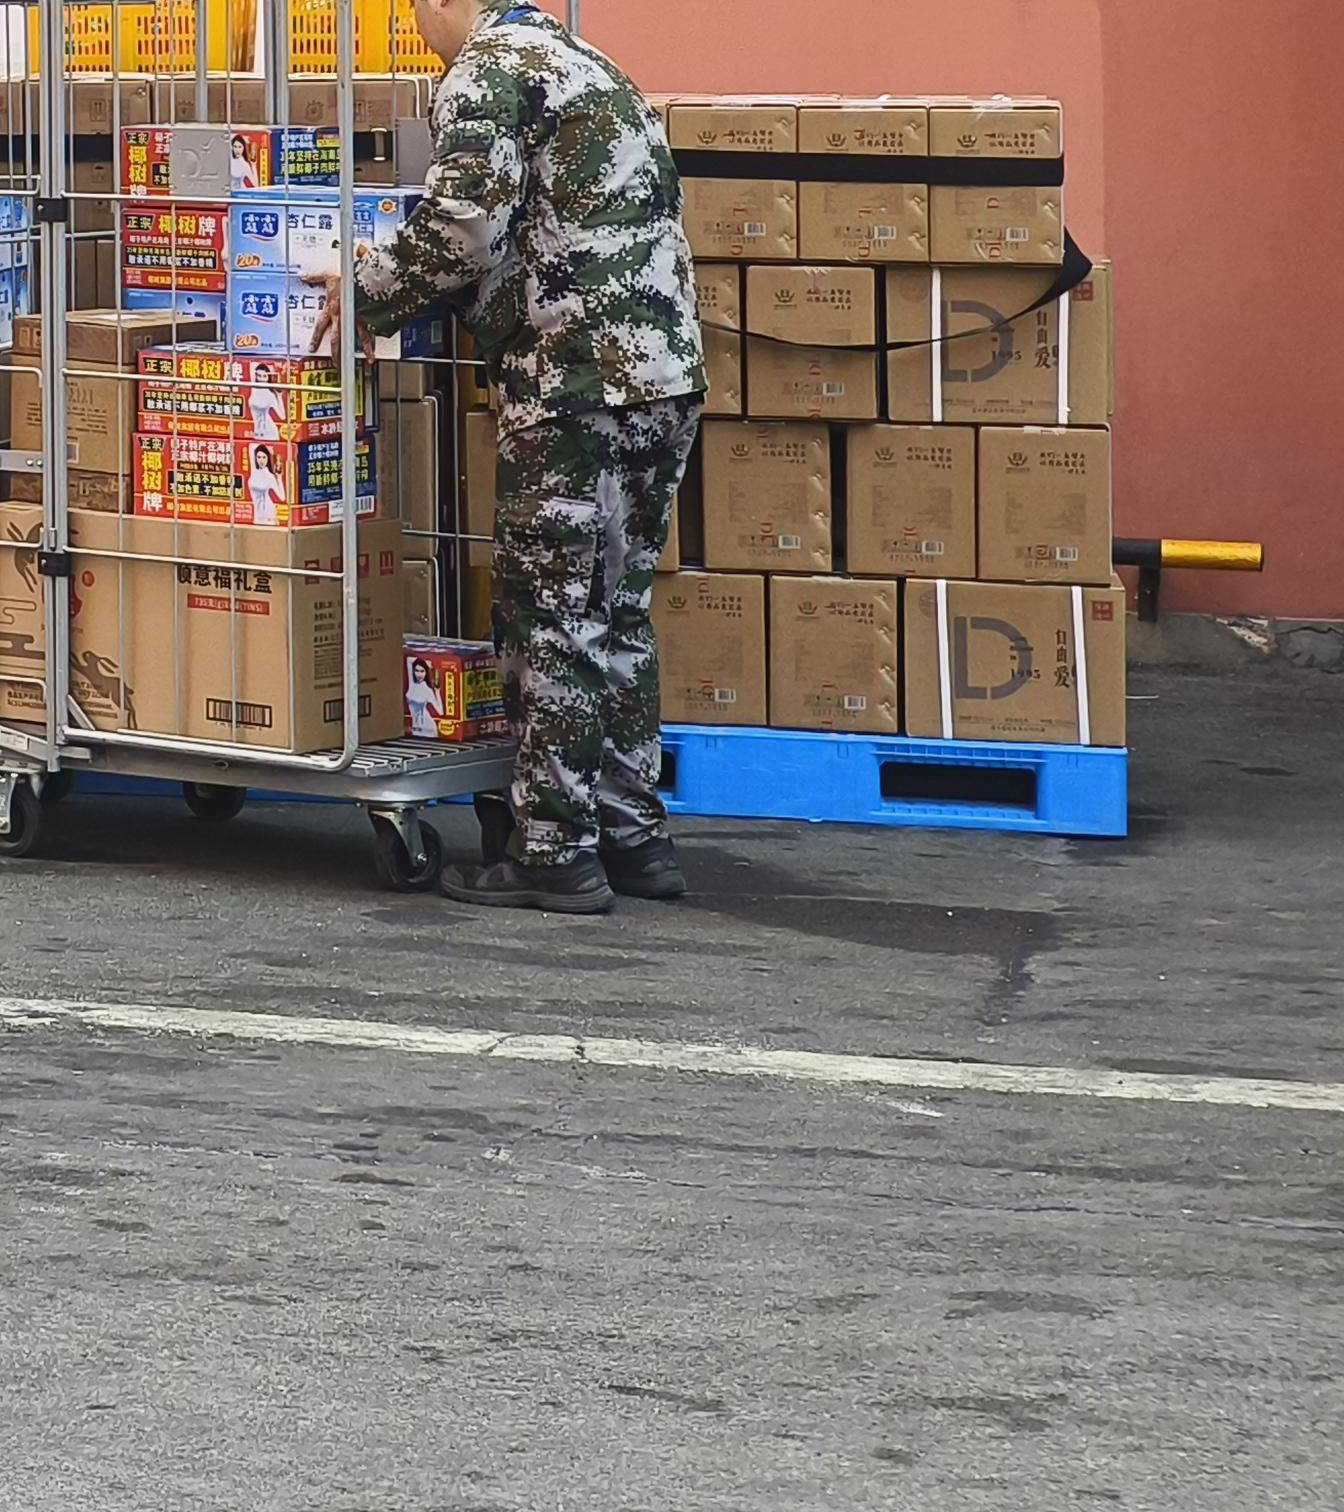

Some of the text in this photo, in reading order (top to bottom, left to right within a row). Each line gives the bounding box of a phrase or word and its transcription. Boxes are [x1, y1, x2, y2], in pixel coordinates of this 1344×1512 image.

[126, 216, 154, 230] 正宗
[145, 359, 174, 373] 正宗
[141, 452, 163, 512] 椰树牌
